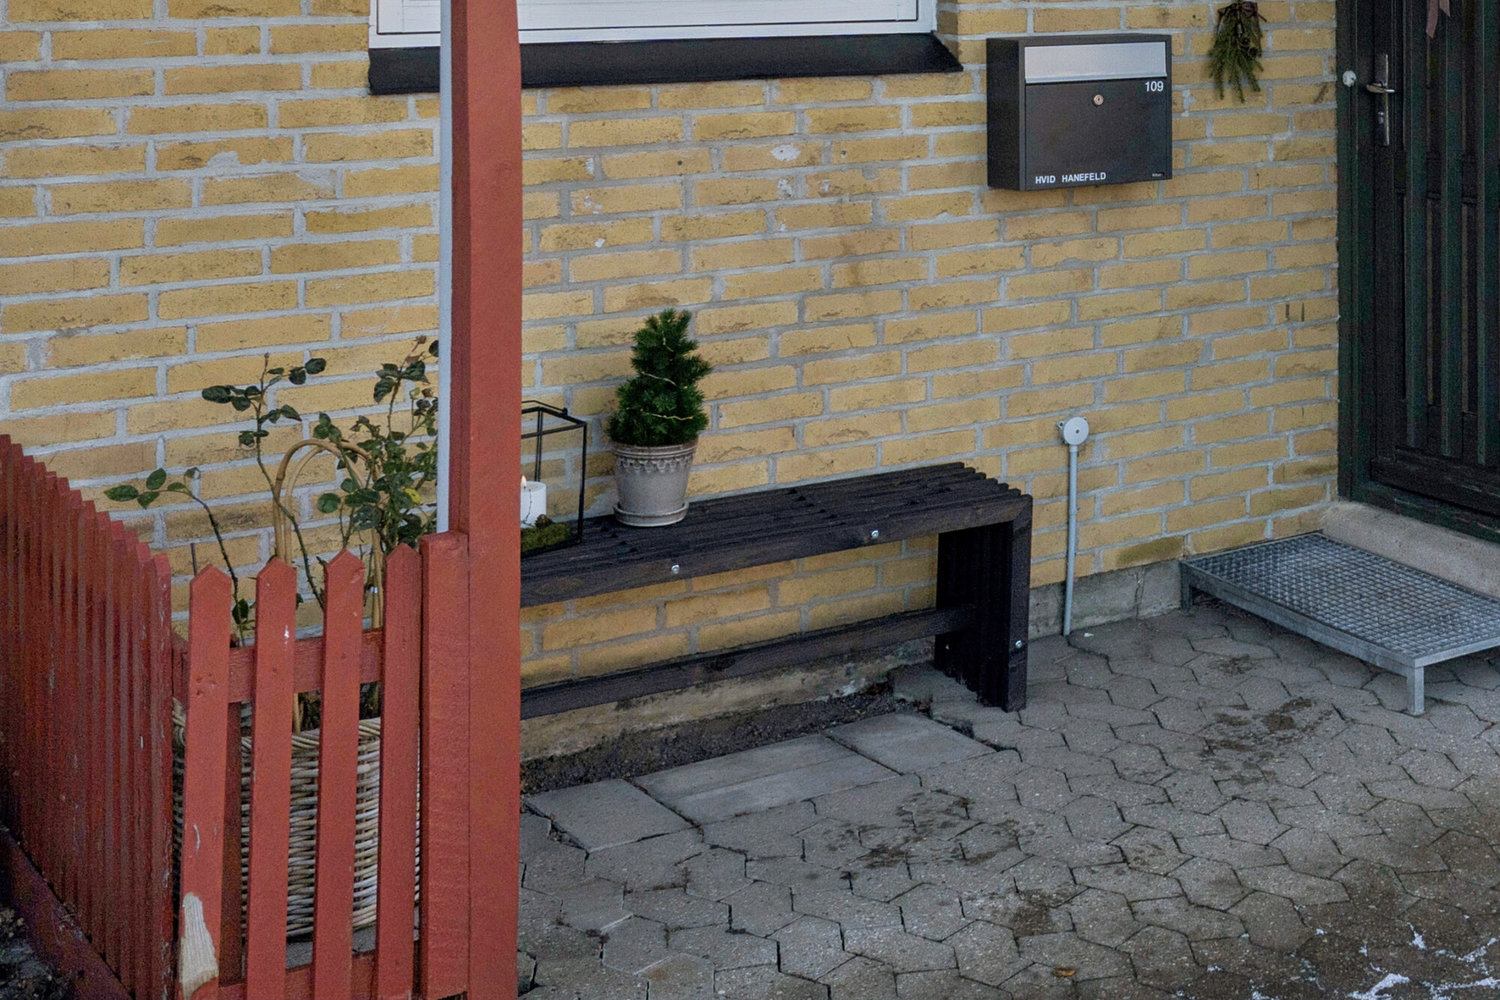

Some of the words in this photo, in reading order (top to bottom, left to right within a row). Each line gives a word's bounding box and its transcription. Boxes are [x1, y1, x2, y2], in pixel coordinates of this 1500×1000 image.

[1145, 81, 1164, 93] 109
[1035, 174, 1056, 184] HVID
[1061, 171, 1107, 183] HANEFELD
